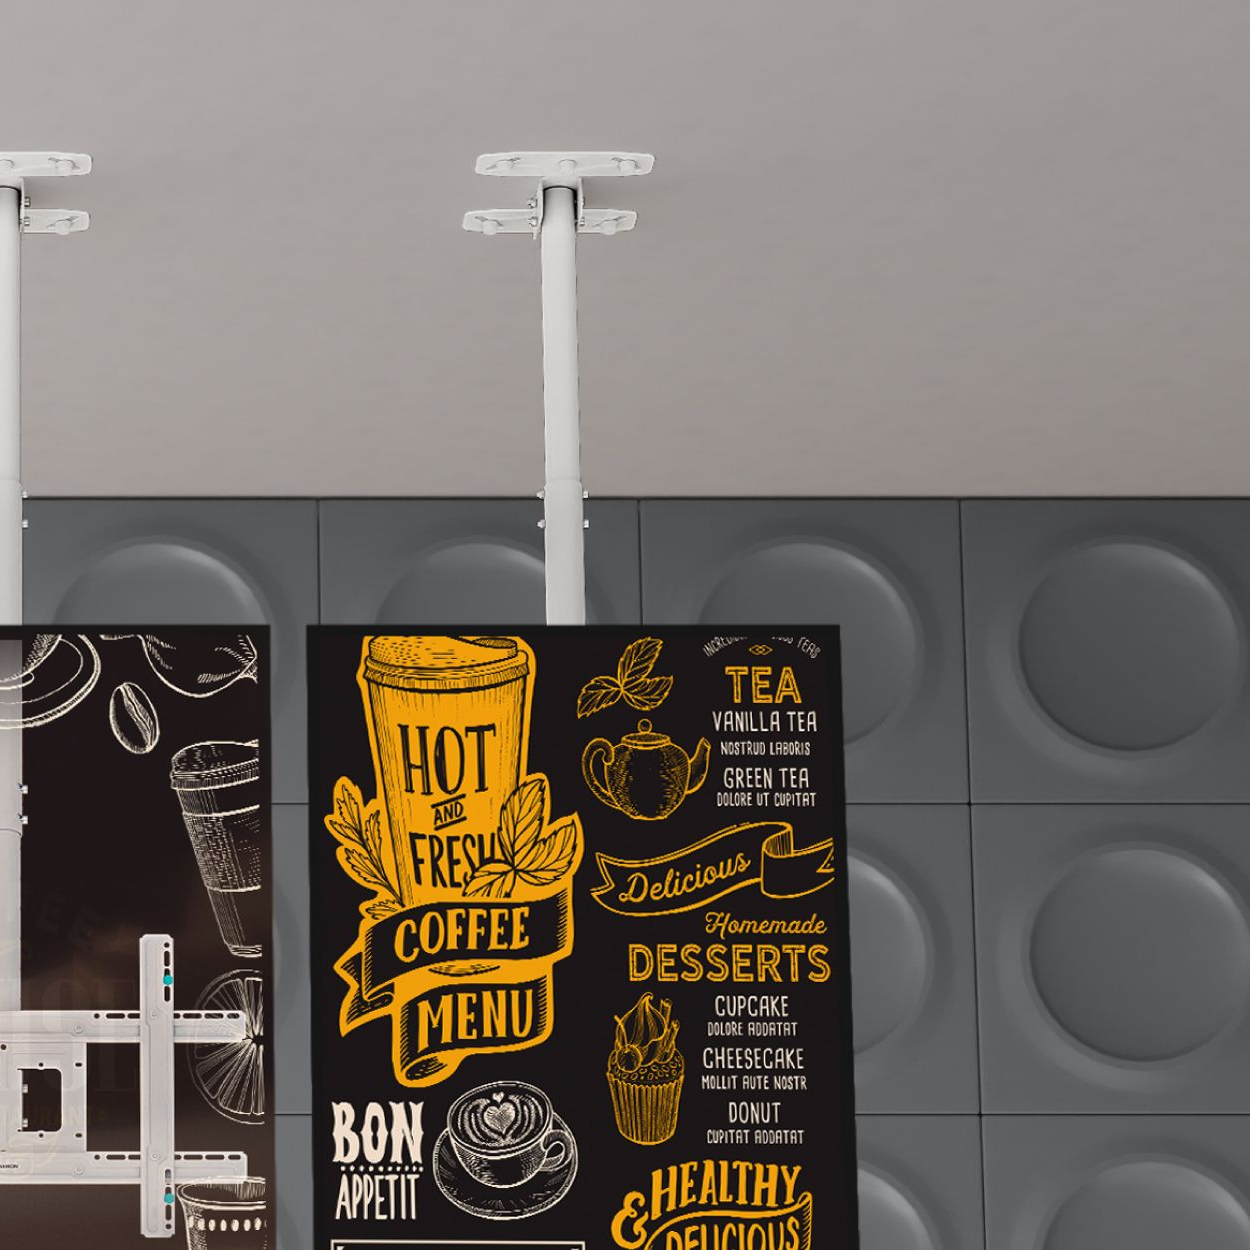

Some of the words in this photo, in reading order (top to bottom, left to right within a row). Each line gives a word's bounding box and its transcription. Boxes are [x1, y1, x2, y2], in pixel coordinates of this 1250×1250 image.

[725, 666, 802, 704] TEA
[712, 711, 780, 732] VANILLA
[787, 711, 818, 732] TEA
[398, 723, 496, 795] HOT
[720, 741, 766, 756] NOSTRUD
[769, 741, 811, 756] LABORIS
[723, 768, 773, 789] GREEN
[779, 768, 809, 788] TEA
[716, 792, 752, 807] DOLORE
[756, 792, 770, 807] UT
[774, 792, 817, 807] CUPITAT
[434, 801, 463, 825] AND
[618, 852, 751, 903] Delicious
[394, 906, 530, 963] COFFEE
[705, 911, 827, 939] Homemade
[628, 943, 831, 982] DESSERTS
[715, 995, 789, 1017] CUPCAKE
[417, 989, 533, 1053] MENU
[707, 1022, 744, 1036] DOLORE
[748, 1022, 798, 1036] ADDATAT
[702, 1047, 804, 1069] CHEESECAKE
[702, 1075, 738, 1090] MOLLIT
[742, 1075, 769, 1090] AUTE
[774, 1075, 807, 1090] NOSTR
[728, 1101, 781, 1123] DONUT
[331, 1101, 425, 1164] BON
[707, 1129, 750, 1144] CUPITAT
[754, 1129, 805, 1144] ADDATAT
[335, 1173, 420, 1220] APPETIT
[651, 1159, 802, 1221] HEALTHY
[611, 1191, 649, 1250] &
